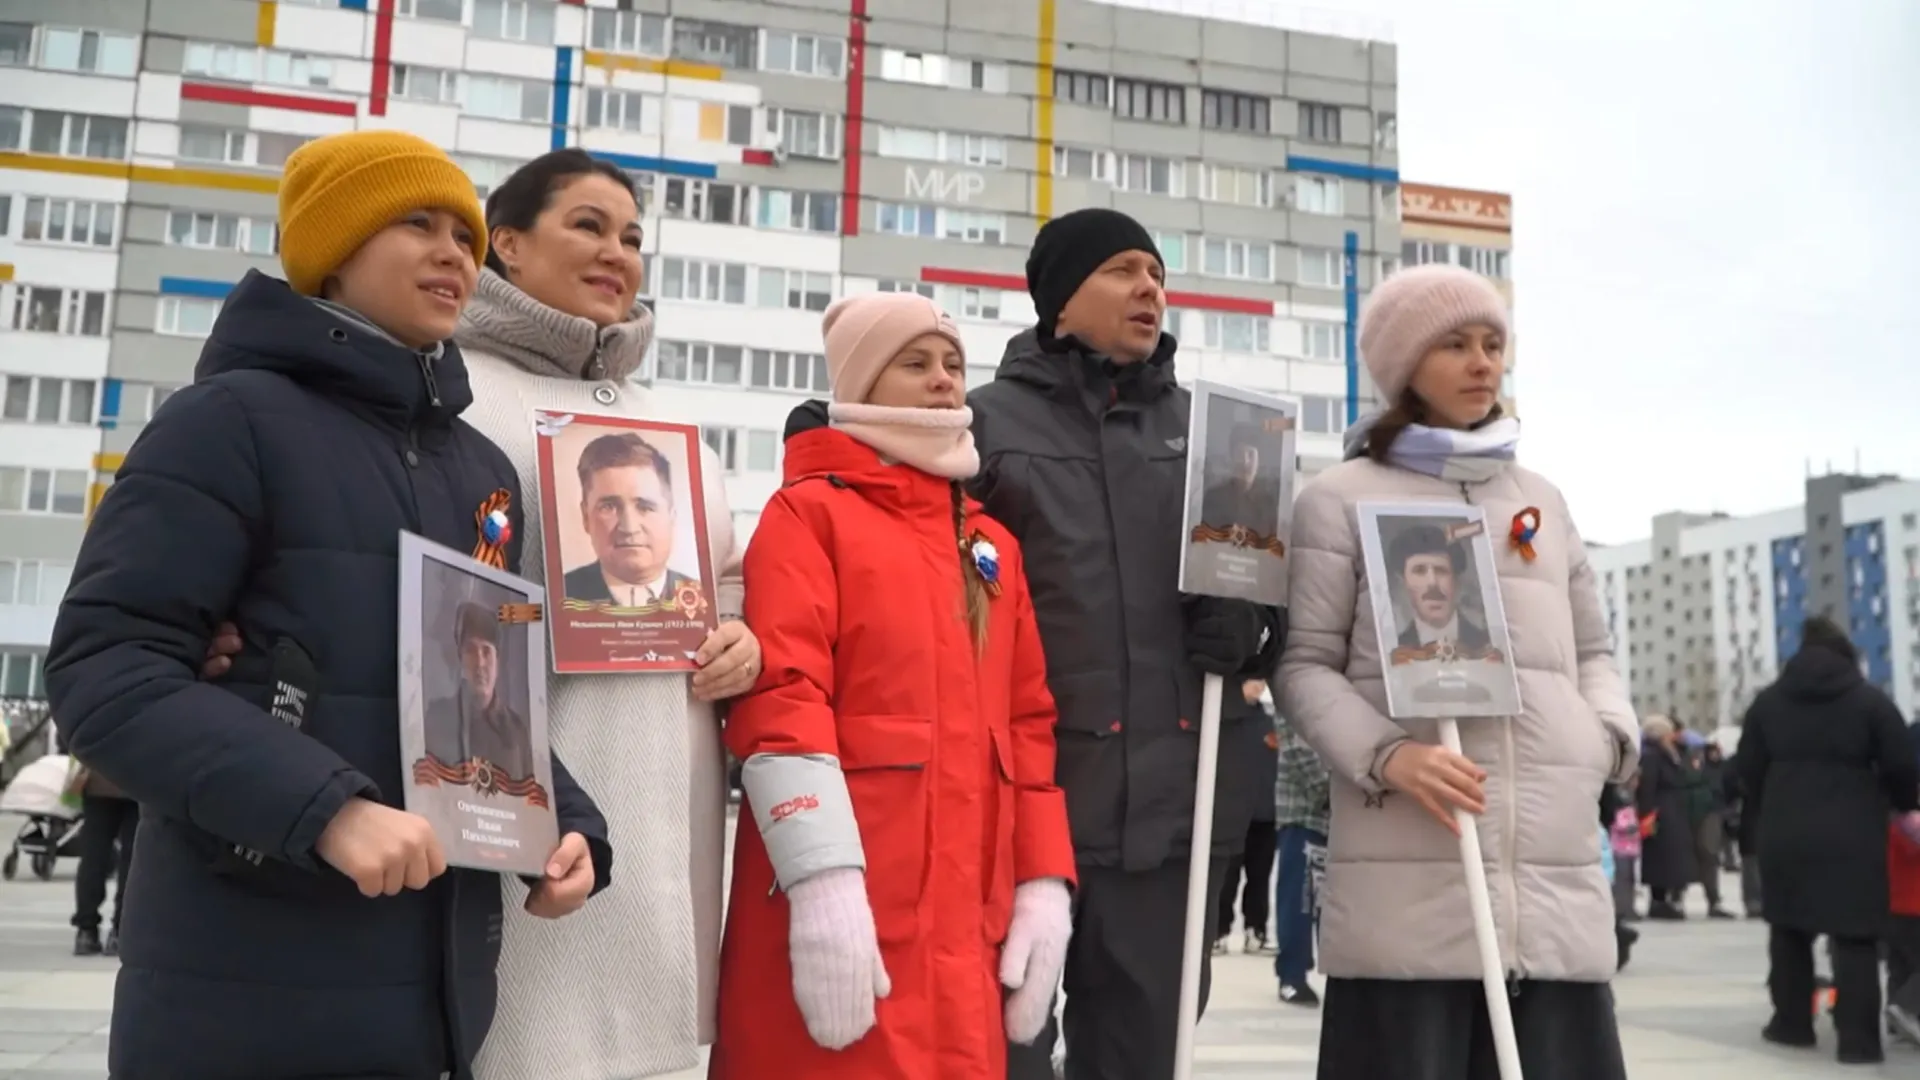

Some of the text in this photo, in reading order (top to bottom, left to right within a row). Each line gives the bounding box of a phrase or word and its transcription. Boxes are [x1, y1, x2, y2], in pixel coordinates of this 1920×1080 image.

[905, 165, 984, 203] МИР
[477, 818, 502, 832] Иван
[462, 828, 520, 848] Николаевич
